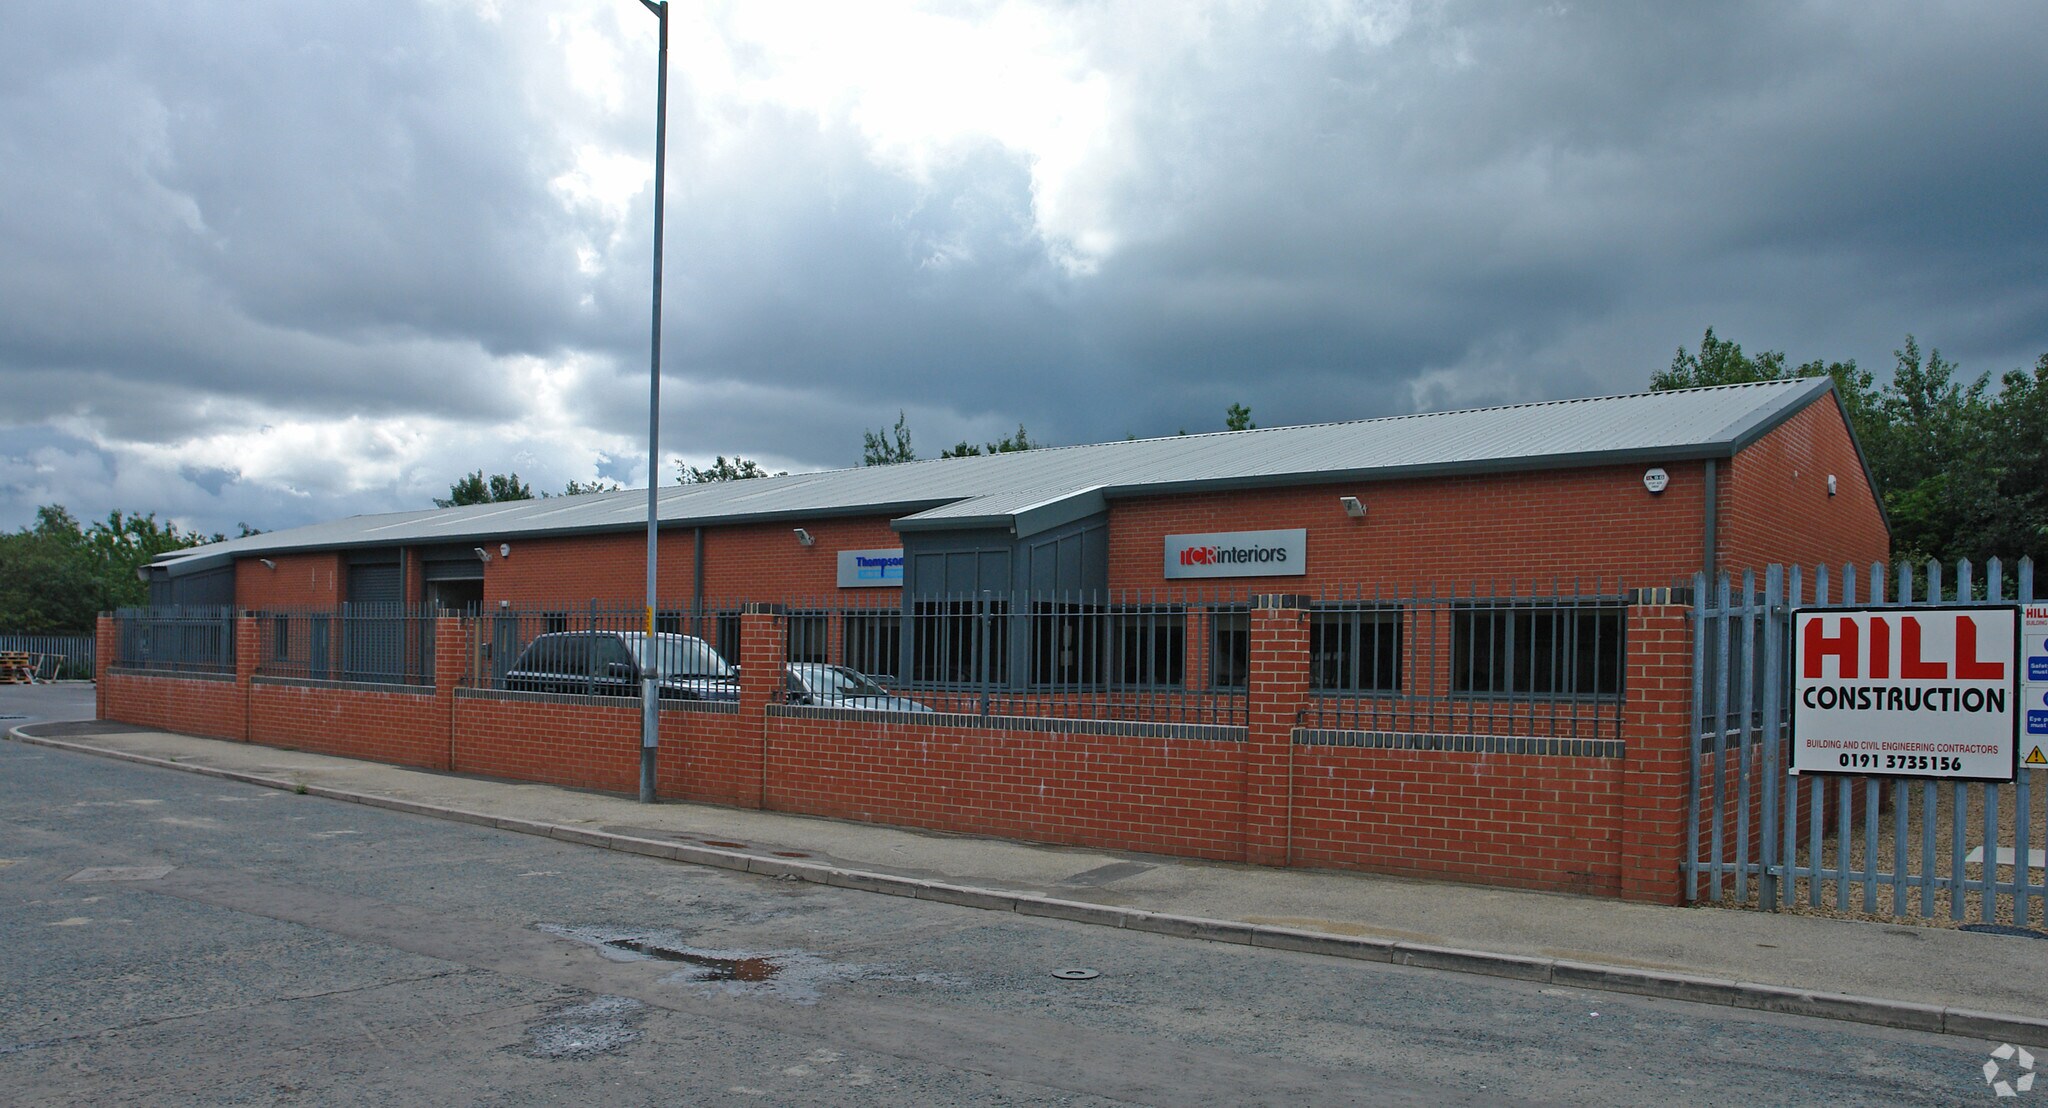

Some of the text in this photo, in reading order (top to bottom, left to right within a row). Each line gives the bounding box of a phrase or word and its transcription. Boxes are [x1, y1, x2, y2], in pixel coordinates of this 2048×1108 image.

[2026, 608, 2048, 618] HILL
[1804, 615, 2005, 680] HILL
[1803, 685, 2005, 713] CONSTRUCTION
[1806, 738, 1999, 755] BUILDING AND CIVIL ENGINEERING CONTRACTORS
[1839, 753, 1961, 771] 0191 3735156
